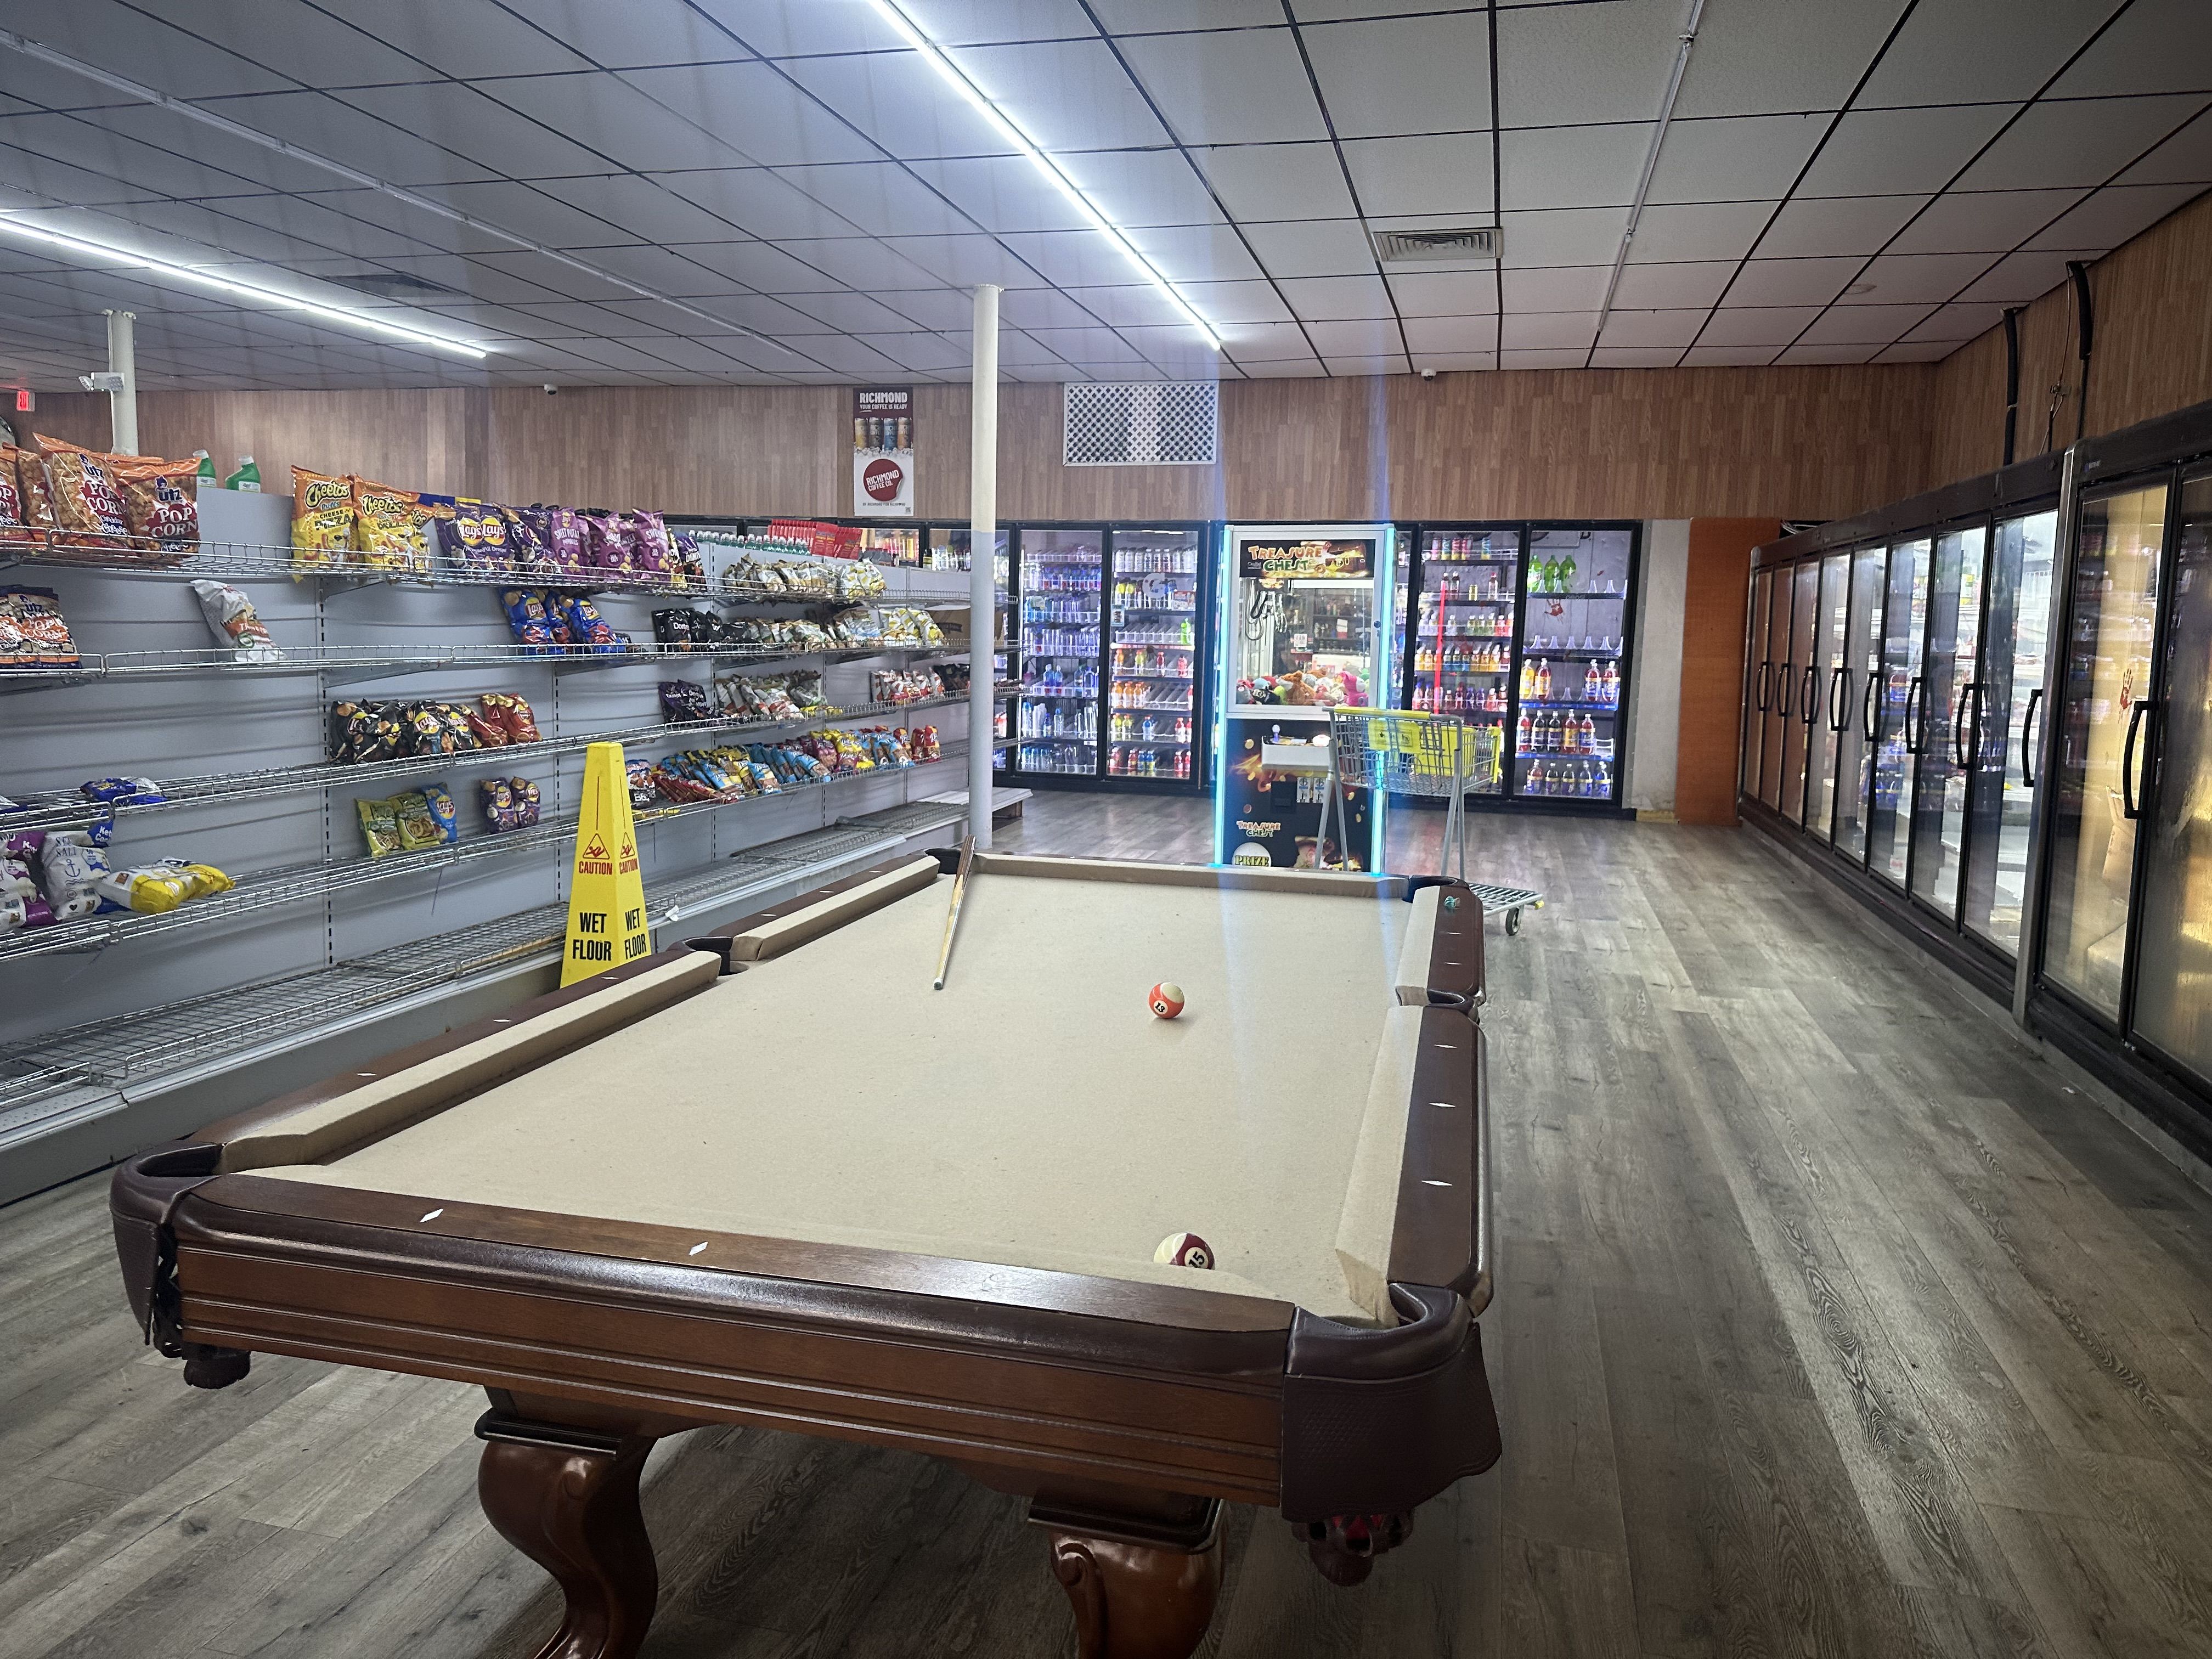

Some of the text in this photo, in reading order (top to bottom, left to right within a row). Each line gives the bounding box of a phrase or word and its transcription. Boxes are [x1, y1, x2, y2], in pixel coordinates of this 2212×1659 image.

[860, 392, 907, 403] RICHMOND
[866, 469, 900, 486] RICHMOND
[306, 481, 349, 508] Cheetos
[868, 482, 886, 492] COFFEE
[363, 495, 403, 516] Cheetos
[159, 506, 193, 523] POP
[320, 509, 343, 519] CHEESE
[151, 520, 197, 538] CORN
[1248, 545, 1323, 560] TREASURE
[1263, 559, 1309, 572] CHEST
[99, 826, 112, 837] Ket
[1237, 821, 1281, 831] TREASURE
[1246, 828, 1273, 837] CHEST
[579, 861, 613, 875] CAUTION
[619, 857, 639, 874] CAUTION
[1234, 855, 1269, 867] PRIZE
[579, 912, 607, 933] WET
[625, 908, 641, 932] WET
[572, 939, 612, 961] FLOOR
[625, 933, 647, 960] FLOOR
[1154, 1002, 1165, 1013] 13
[1188, 1251, 1205, 1268] 15
